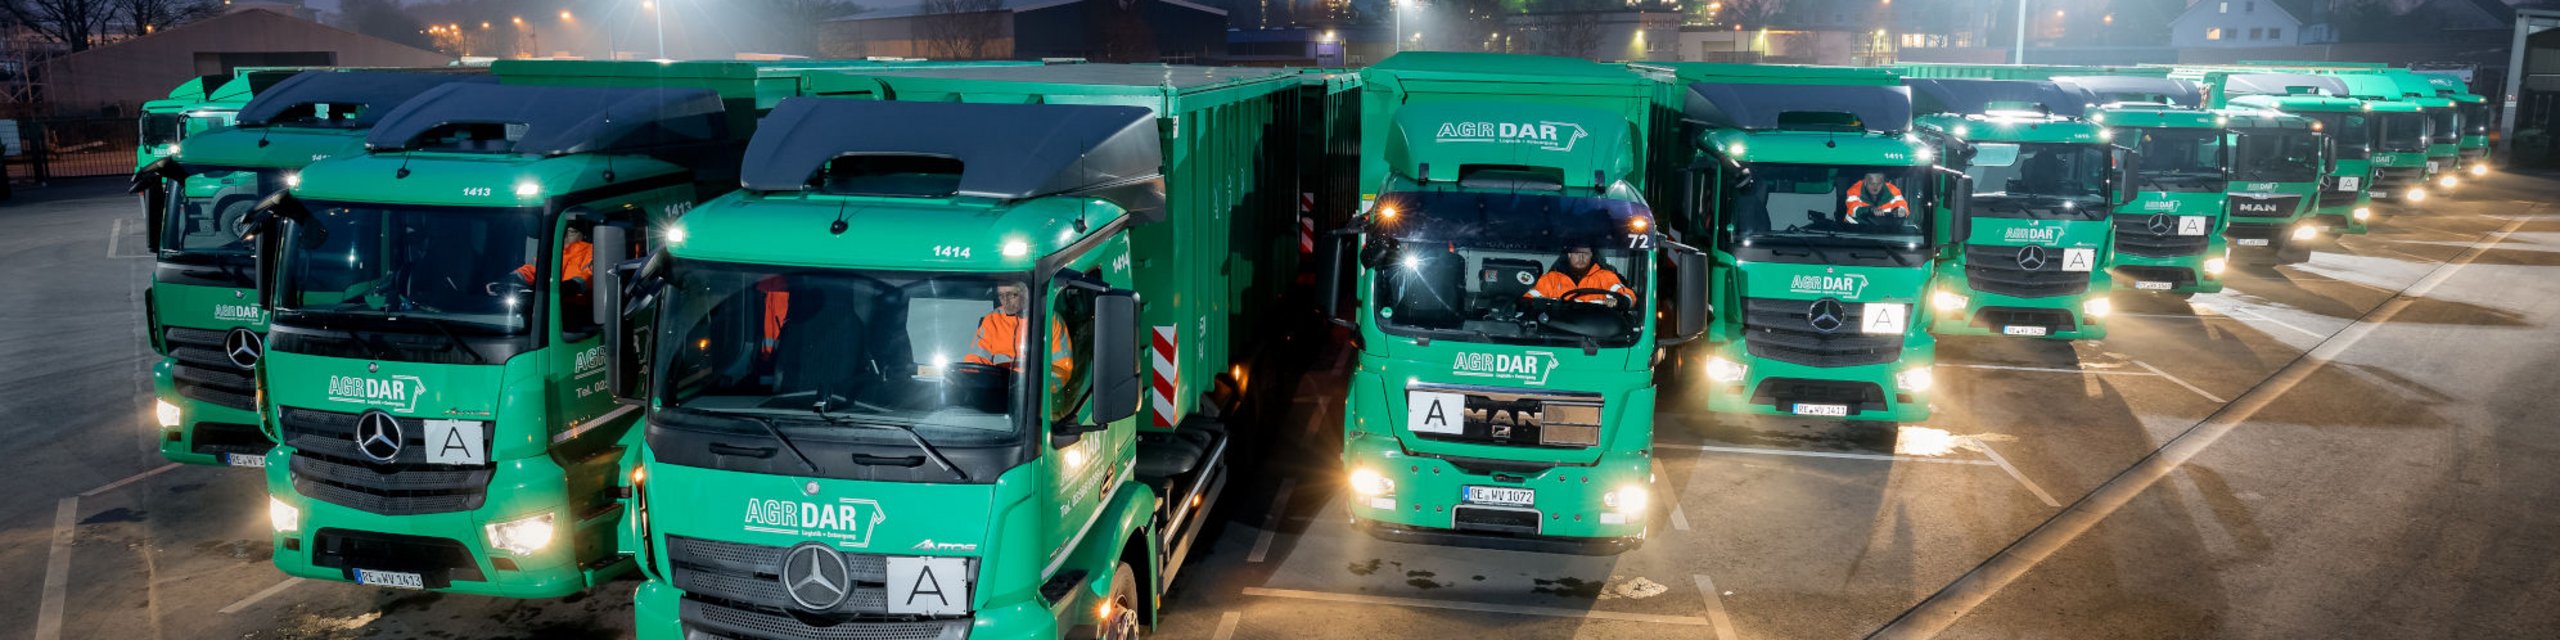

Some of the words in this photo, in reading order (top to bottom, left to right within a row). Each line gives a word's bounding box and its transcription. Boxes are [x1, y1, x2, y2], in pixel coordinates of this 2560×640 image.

[1499, 122, 1558, 141] DAR
[463, 187, 492, 197] 1413
[2240, 203, 2277, 212] MAN
[2029, 228, 2054, 240] DAR
[2184, 218, 2199, 233] A
[1627, 233, 1650, 249] 72
[932, 244, 971, 259] 1414
[2069, 251, 2086, 268] A
[1823, 276, 1854, 291] DAR
[1872, 308, 1893, 328] A
[1496, 354, 1538, 375] DAR
[366, 378, 405, 401] DAR
[1424, 399, 1447, 427] A
[1464, 407, 1543, 428] MAN
[439, 426, 472, 458] A
[1470, 487, 1484, 500] RE
[1491, 489, 1505, 501] WV
[1507, 490, 1533, 503] 1072
[744, 498, 798, 528] AGR
[801, 502, 857, 532] DAR
[361, 571, 376, 583] RE
[396, 575, 422, 587] 1413
[905, 565, 949, 606] A
